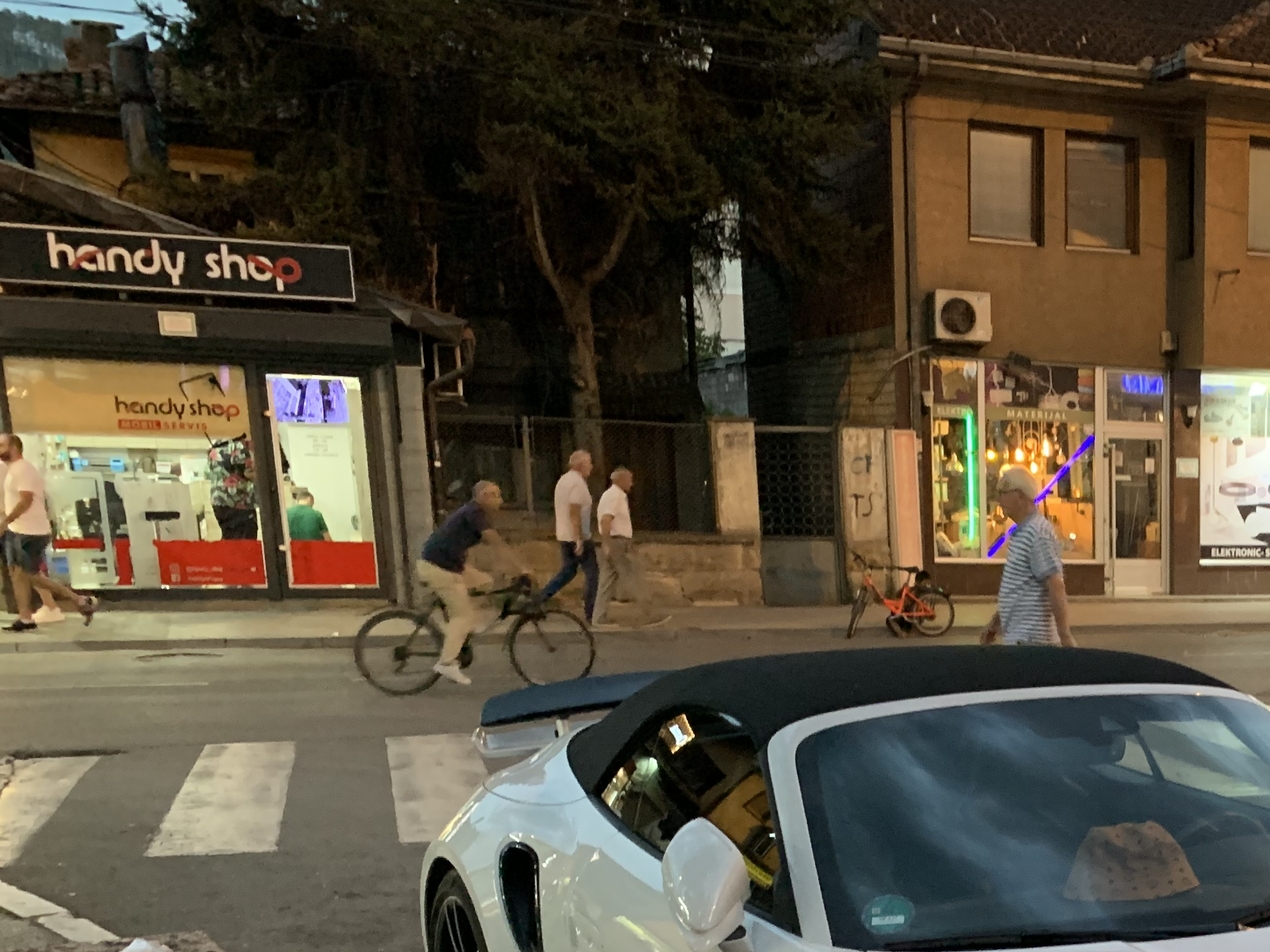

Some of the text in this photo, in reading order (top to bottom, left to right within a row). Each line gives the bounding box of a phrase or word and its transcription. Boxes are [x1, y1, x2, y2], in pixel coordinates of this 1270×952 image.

[46, 231, 302, 292] handy shop
[114, 395, 240, 422] handy shop
[1006, 409, 1067, 420] MATERIJAL
